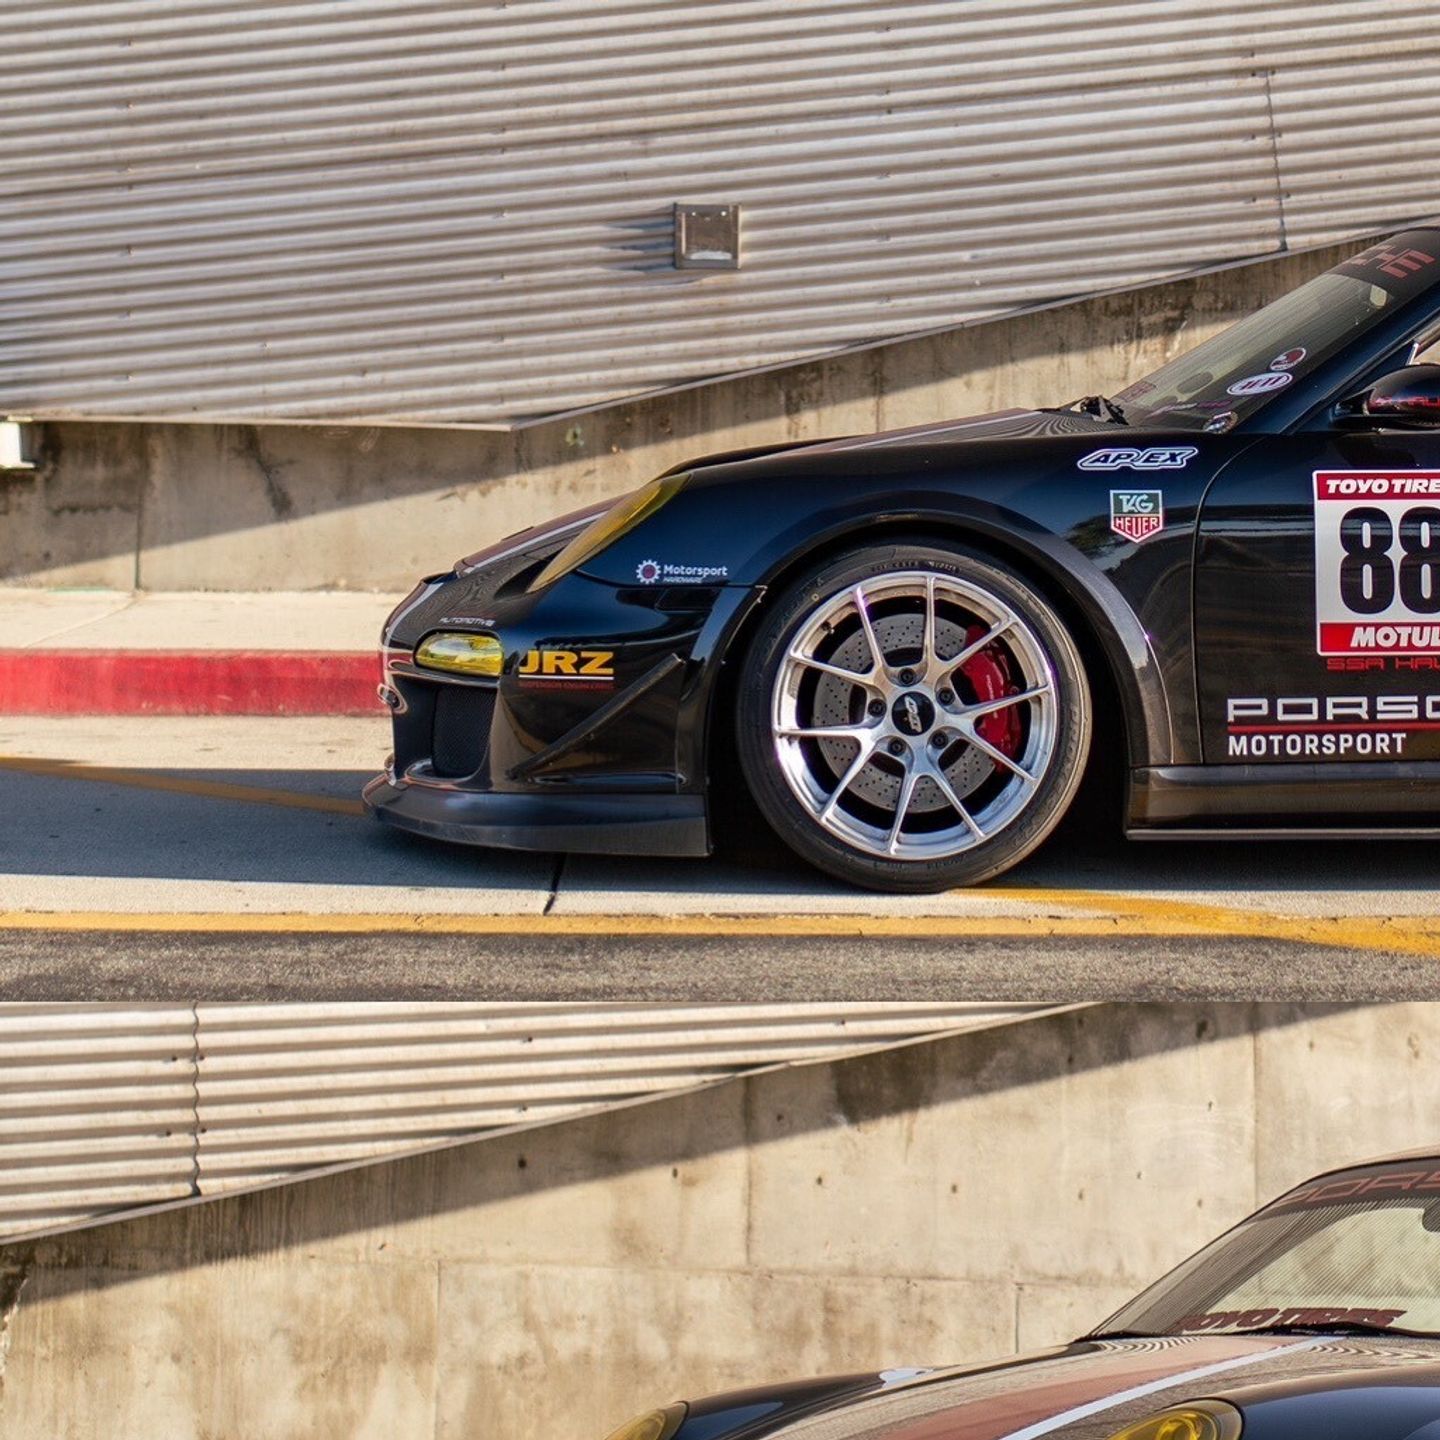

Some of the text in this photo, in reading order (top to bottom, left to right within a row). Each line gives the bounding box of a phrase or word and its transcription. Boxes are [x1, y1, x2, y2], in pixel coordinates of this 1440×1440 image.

[1326, 479, 1390, 494] TOYO
[1118, 494, 1154, 514] TAG
[1115, 516, 1159, 537] HEUER
[663, 564, 728, 577] Motorsport
[519, 650, 614, 675] JRZ
[1327, 657, 1385, 672] SSA
[1228, 732, 1407, 756] MOTORSPORT
